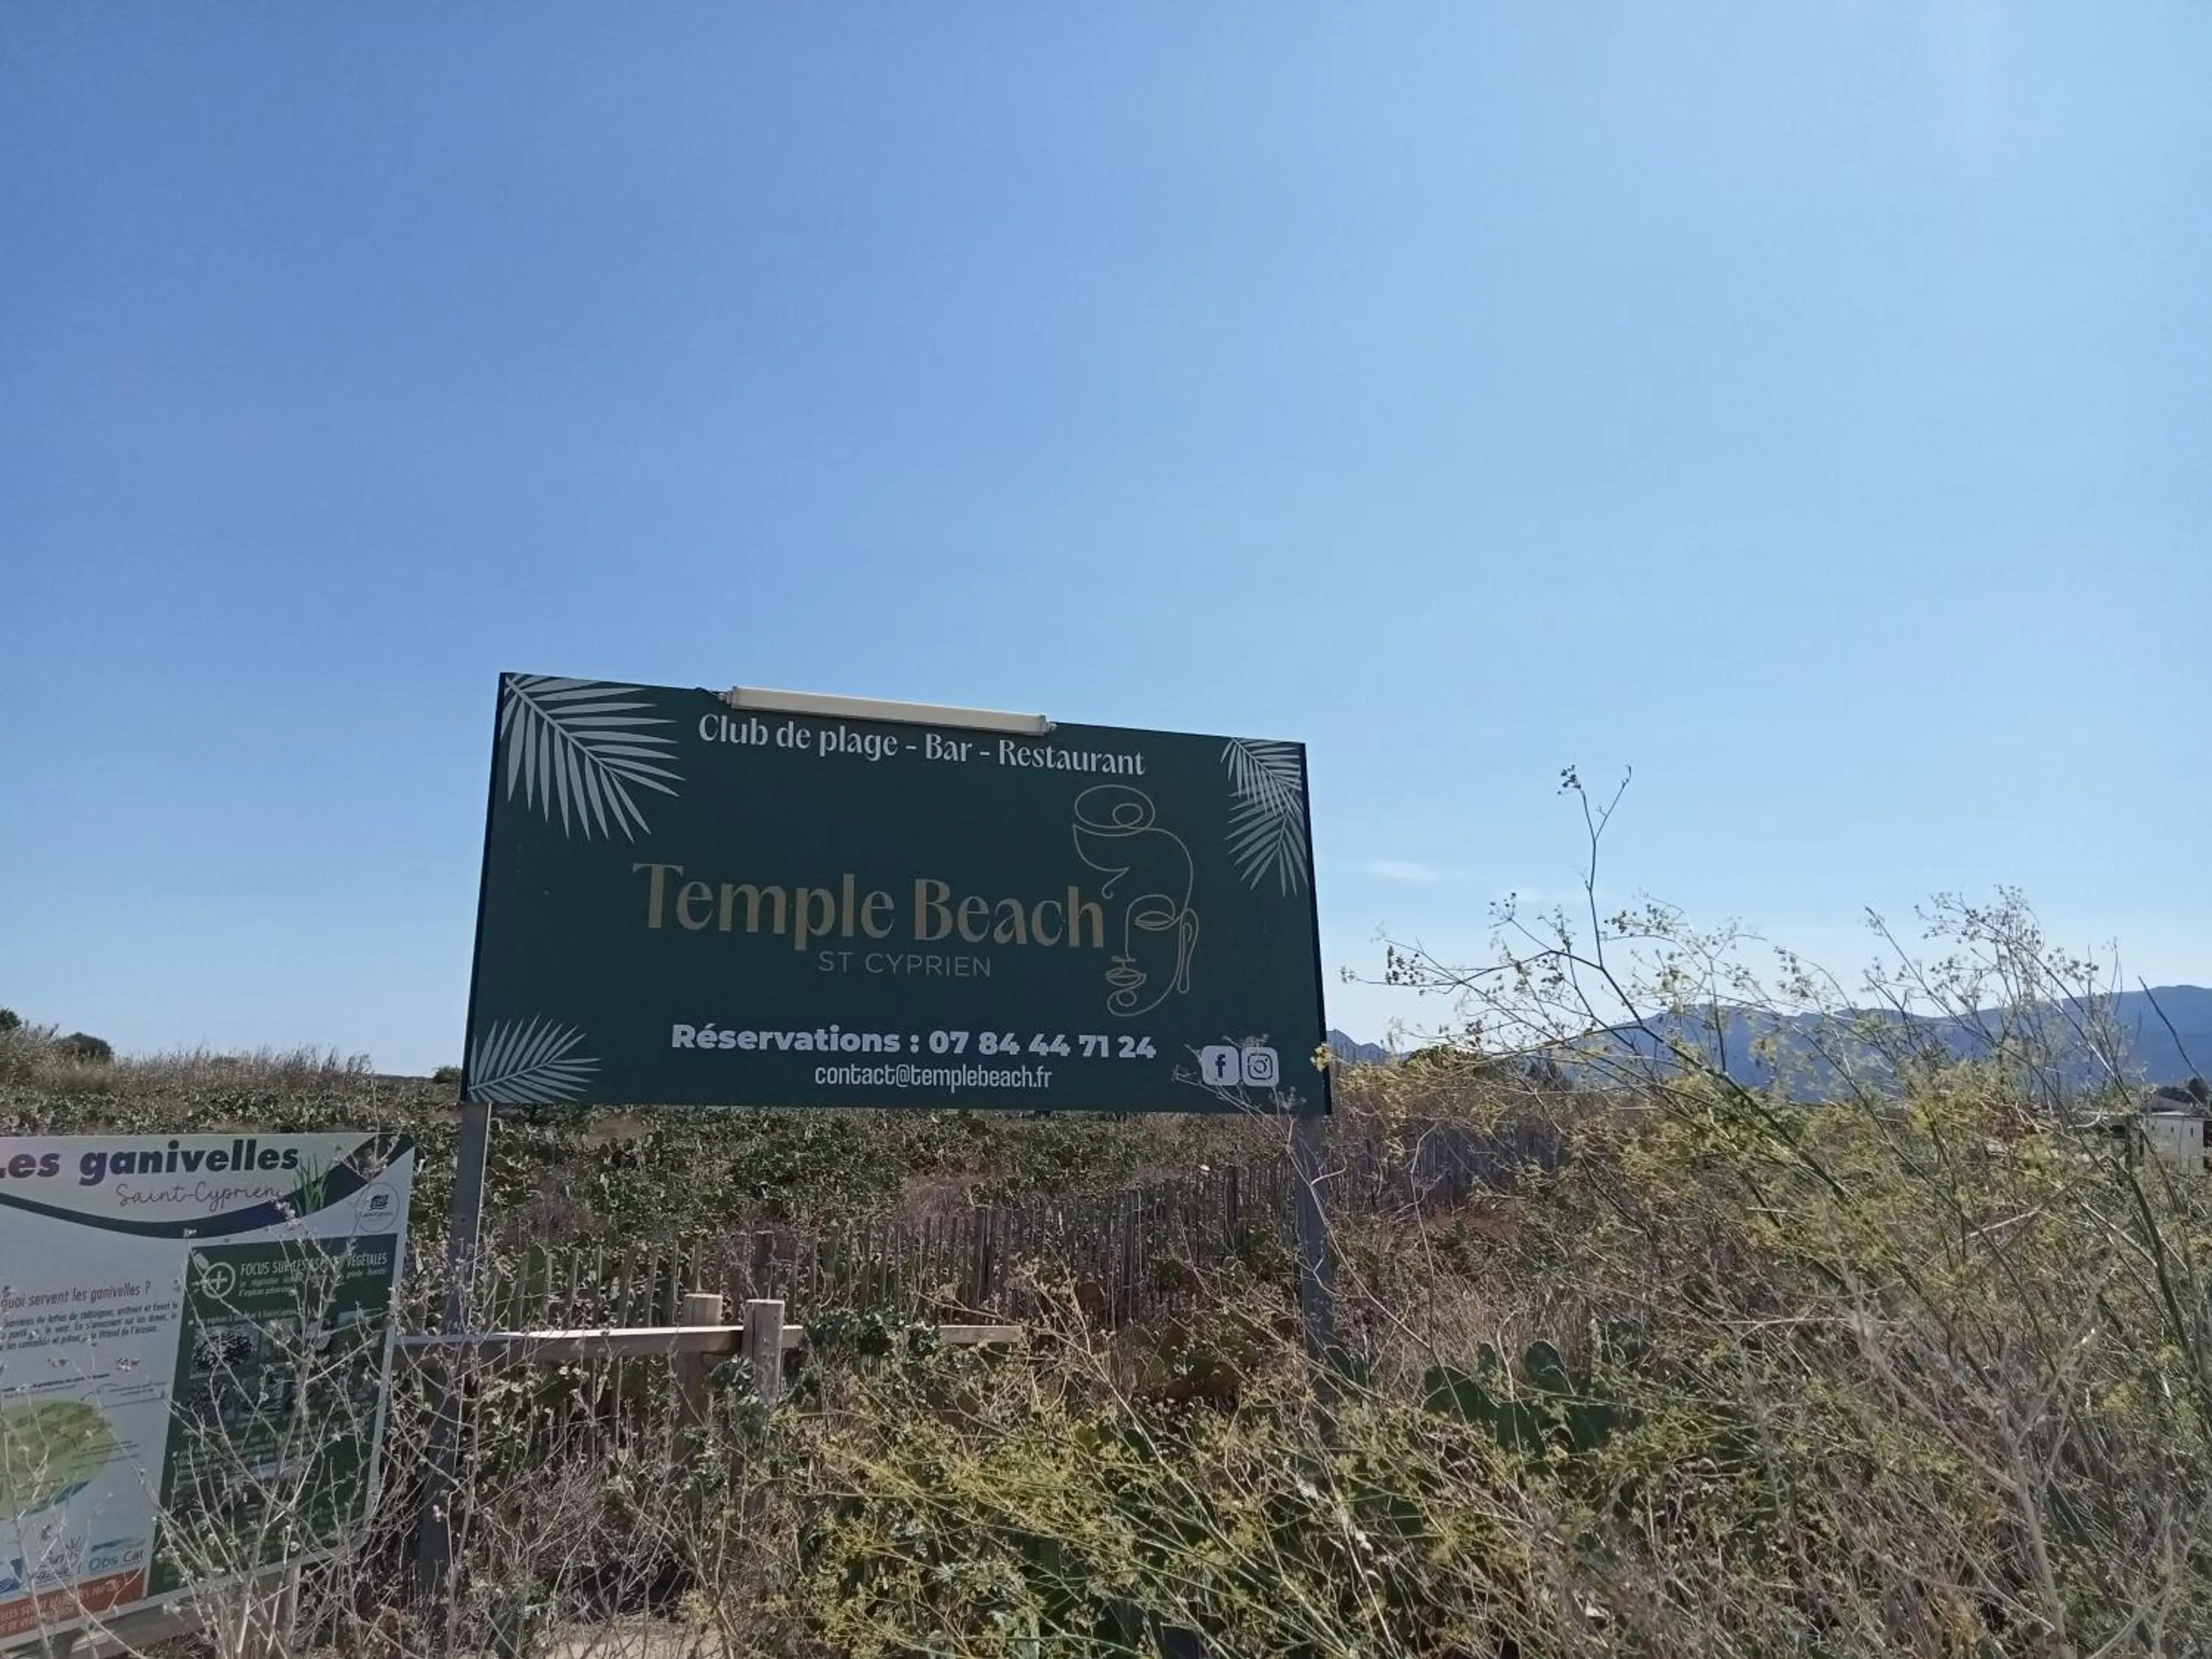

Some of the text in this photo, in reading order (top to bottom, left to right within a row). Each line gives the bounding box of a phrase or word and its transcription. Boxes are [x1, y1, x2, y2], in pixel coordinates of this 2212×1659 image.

[698, 713, 769, 746] Club
[776, 720, 812, 750] de
[819, 725, 899, 762] plage
[925, 733, 973, 762] Bar
[998, 739, 1146, 776] Restaurant
[632, 861, 1105, 951] Temple Beach
[817, 950, 992, 978] ST CYPRIEN
[672, 1023, 901, 1053] Réservations
[928, 1030, 970, 1054] 07
[978, 1032, 1020, 1056] 84
[1028, 1033, 1071, 1057] 44
[1078, 1034, 1110, 1058] 71
[1117, 1035, 1158, 1060] 24
[814, 1063, 1053, 1093] contact@templebeach.fr
[78, 1138, 299, 1186] ganivelles
[116, 1180, 283, 1214] Saint-Cyprien
[240, 1262, 270, 1276] FOCUS
[28, 1289, 69, 1307] servent
[73, 1287, 88, 1302] les
[91, 1281, 142, 1304] ganivelles
